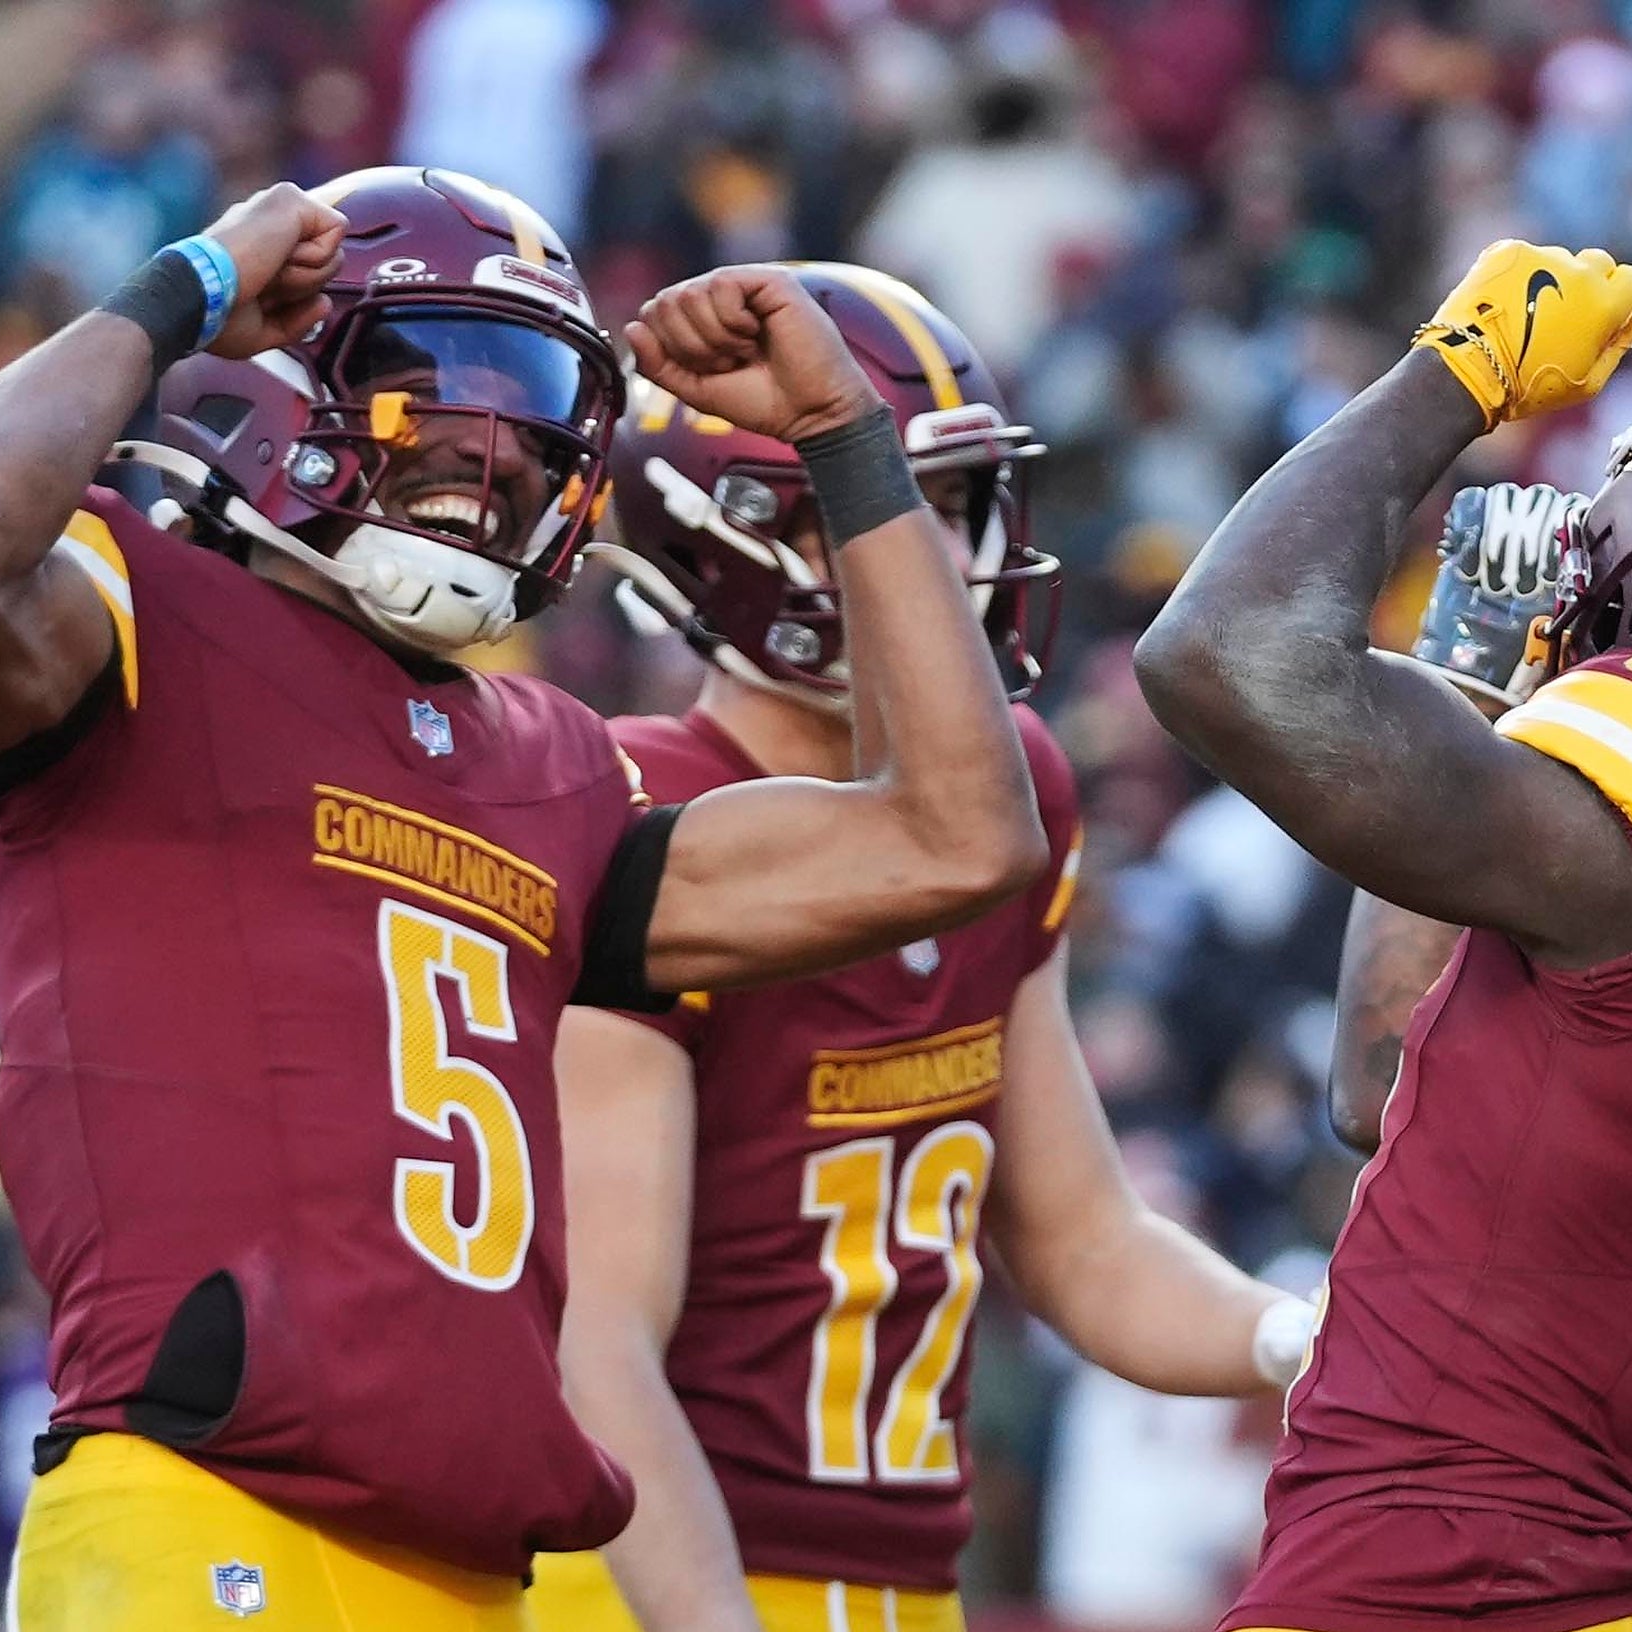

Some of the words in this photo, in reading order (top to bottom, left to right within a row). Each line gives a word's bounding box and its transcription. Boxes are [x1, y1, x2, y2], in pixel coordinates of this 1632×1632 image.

[314, 798, 558, 941] COMMANDERS
[378, 898, 535, 1292] 5
[800, 1119, 995, 1485] 12
